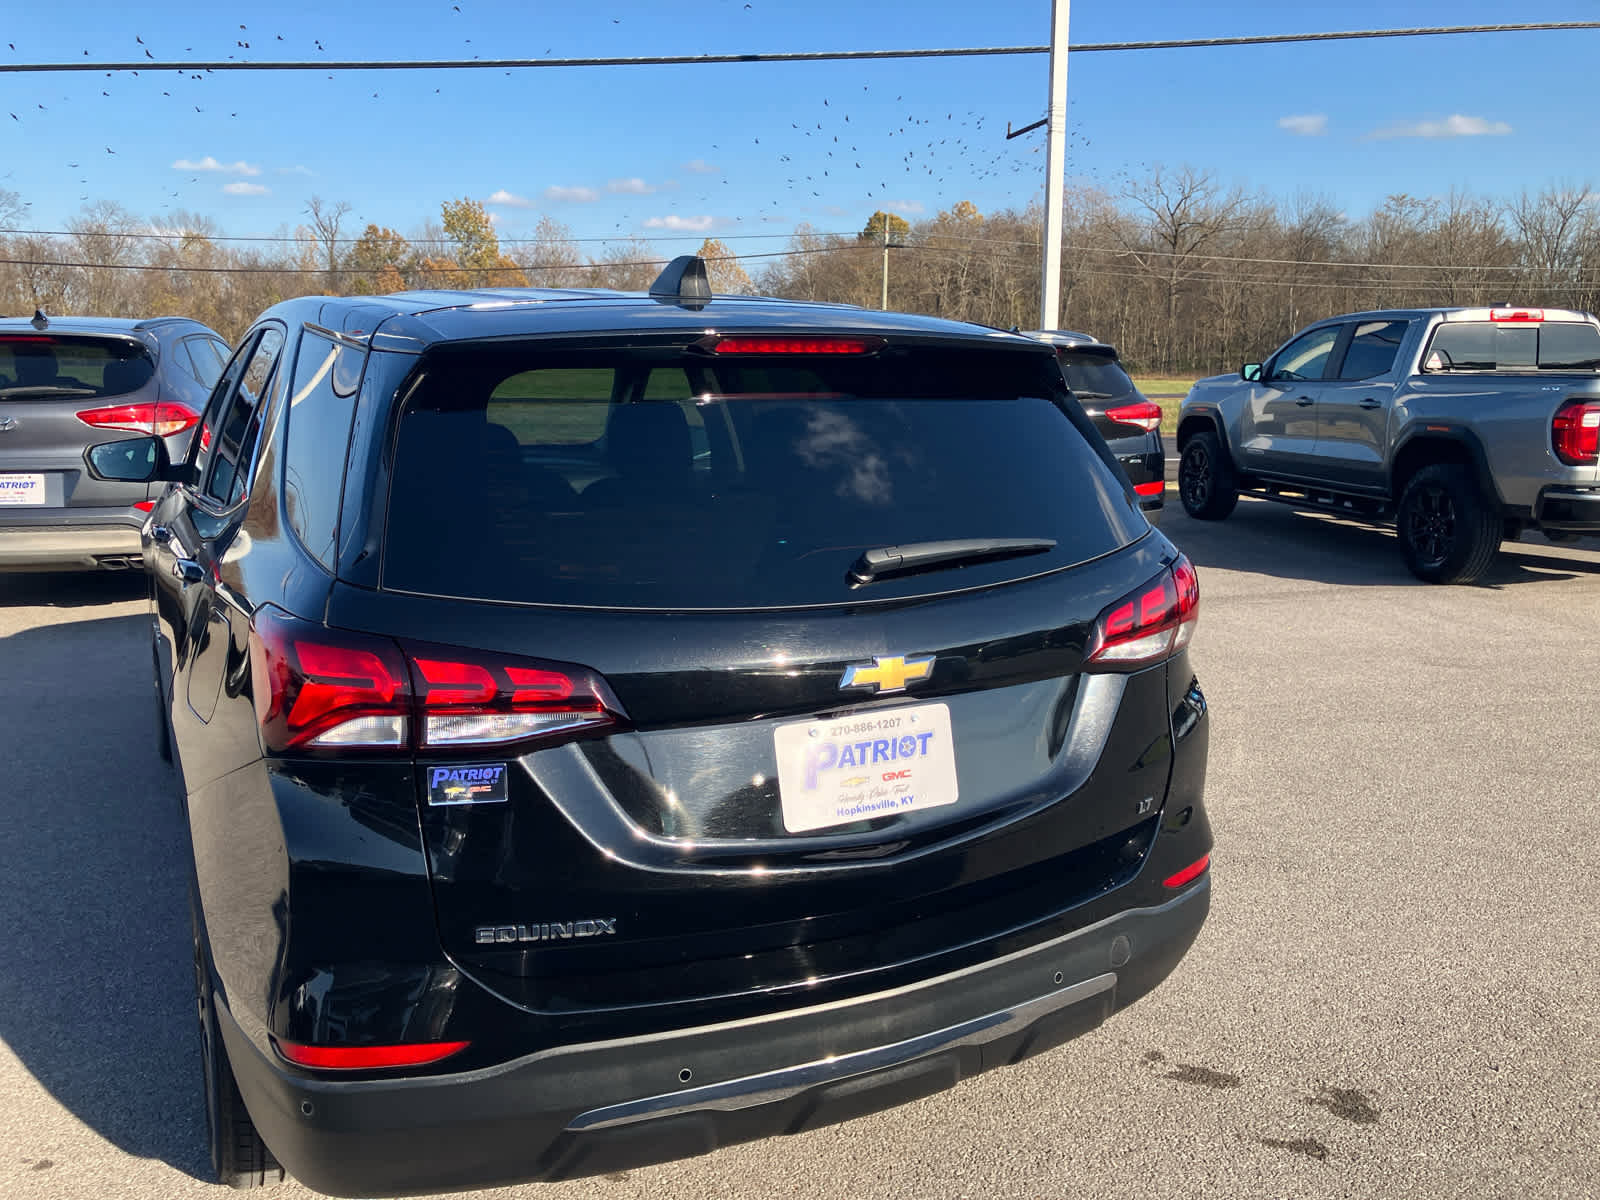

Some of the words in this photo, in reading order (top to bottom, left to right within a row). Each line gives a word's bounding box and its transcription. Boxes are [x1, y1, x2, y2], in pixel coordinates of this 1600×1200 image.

[831, 717, 902, 736] 270-886-1207
[805, 732, 933, 790] PATRIOT
[432, 767, 503, 789] PATRIOT
[882, 769, 912, 782] GMC
[836, 802, 899, 817] Hopkinsville,
[901, 795, 915, 805] KY
[475, 918, 617, 943] EQUINOX
